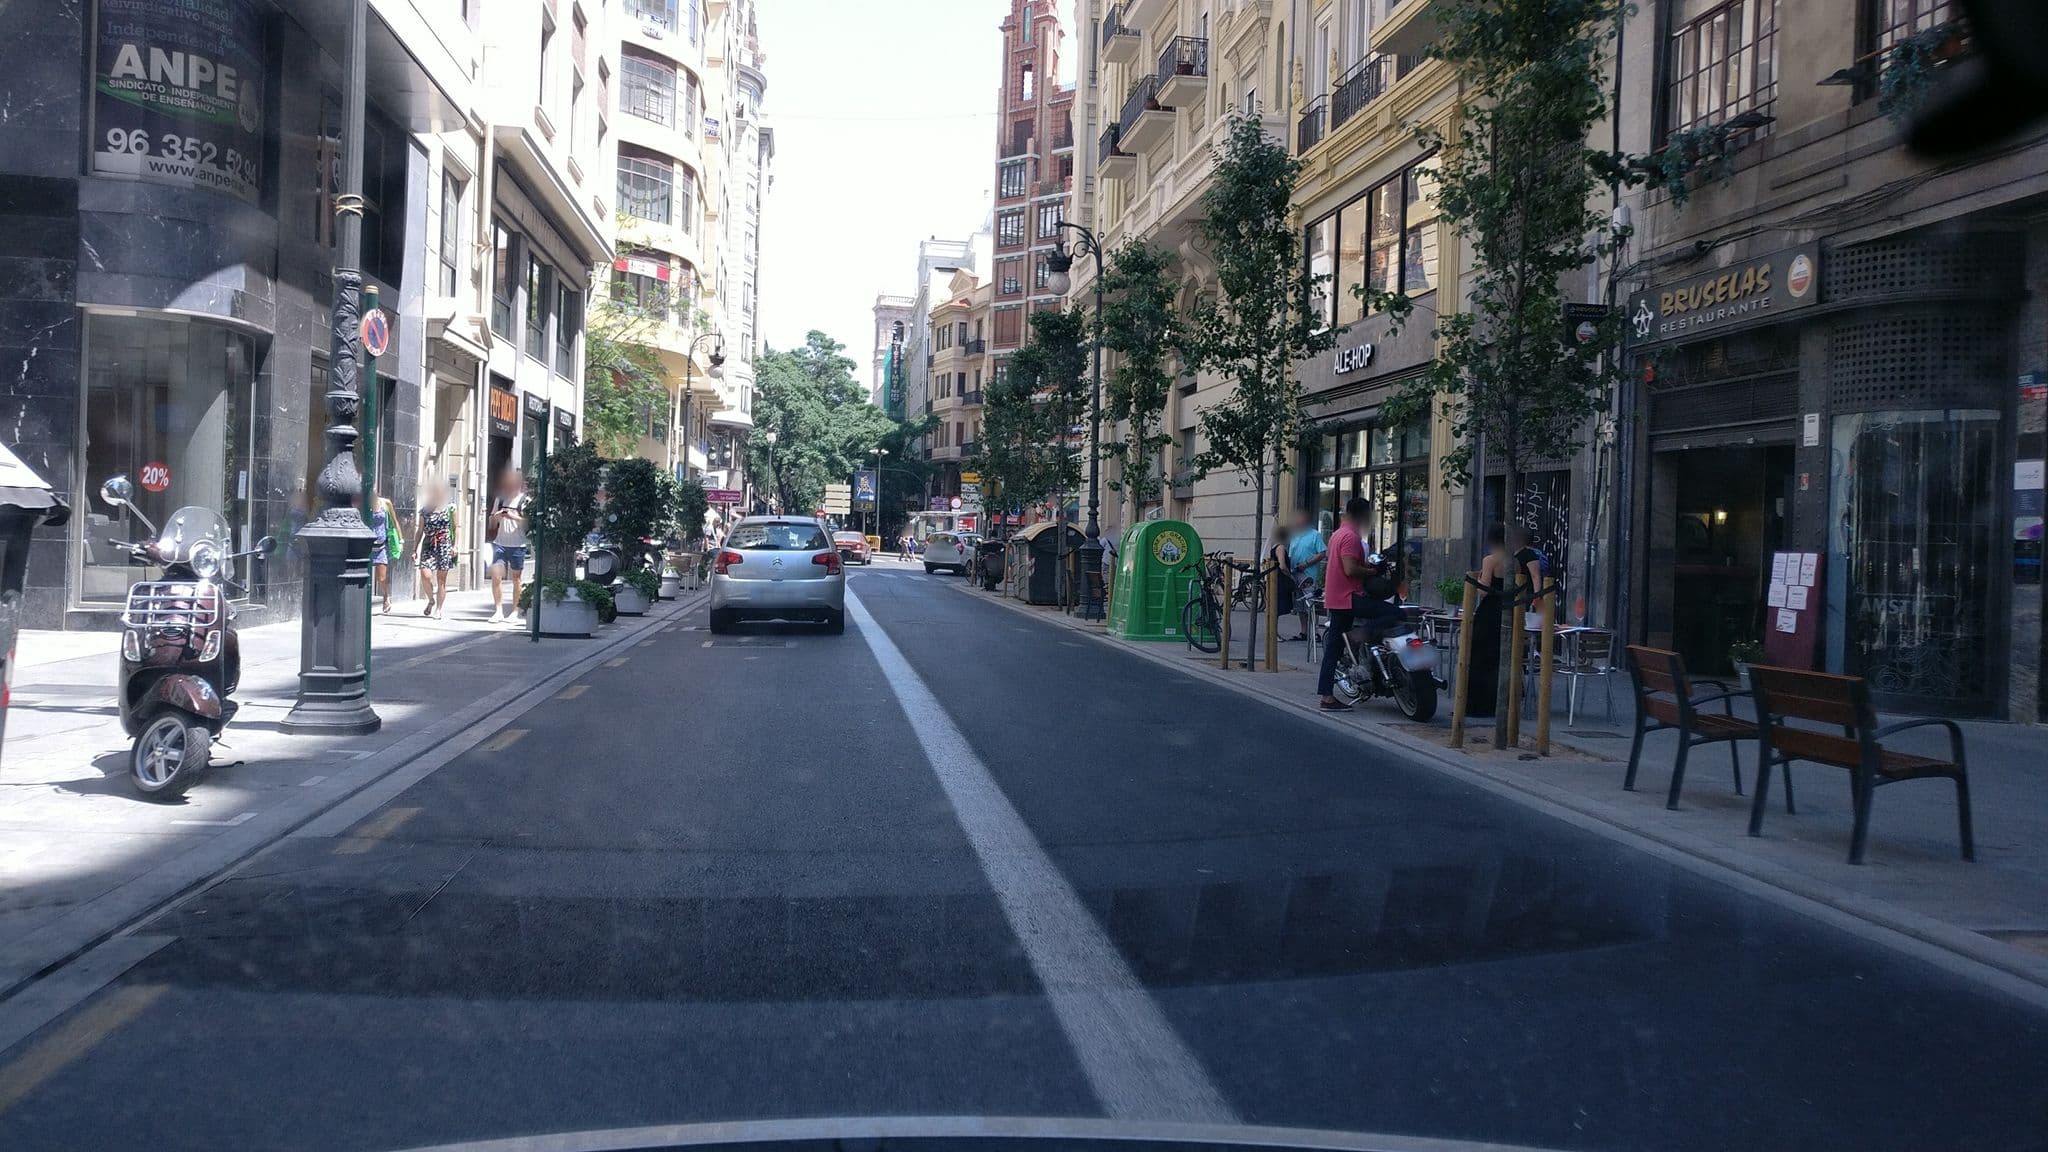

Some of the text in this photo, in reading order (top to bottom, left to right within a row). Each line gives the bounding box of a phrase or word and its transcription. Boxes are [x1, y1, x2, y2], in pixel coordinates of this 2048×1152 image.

[108, 79, 167, 94] SINDICATO
[110, 43, 238, 102] ANPE
[142, 92, 216, 115] DE ENSEÑANZA
[107, 127, 150, 156] 96
[161, 133, 218, 167] 352
[1660, 263, 1772, 317] BRUSELAS
[1660, 297, 1771, 333] RESTAURANTE
[142, 466, 169, 487] 20%
